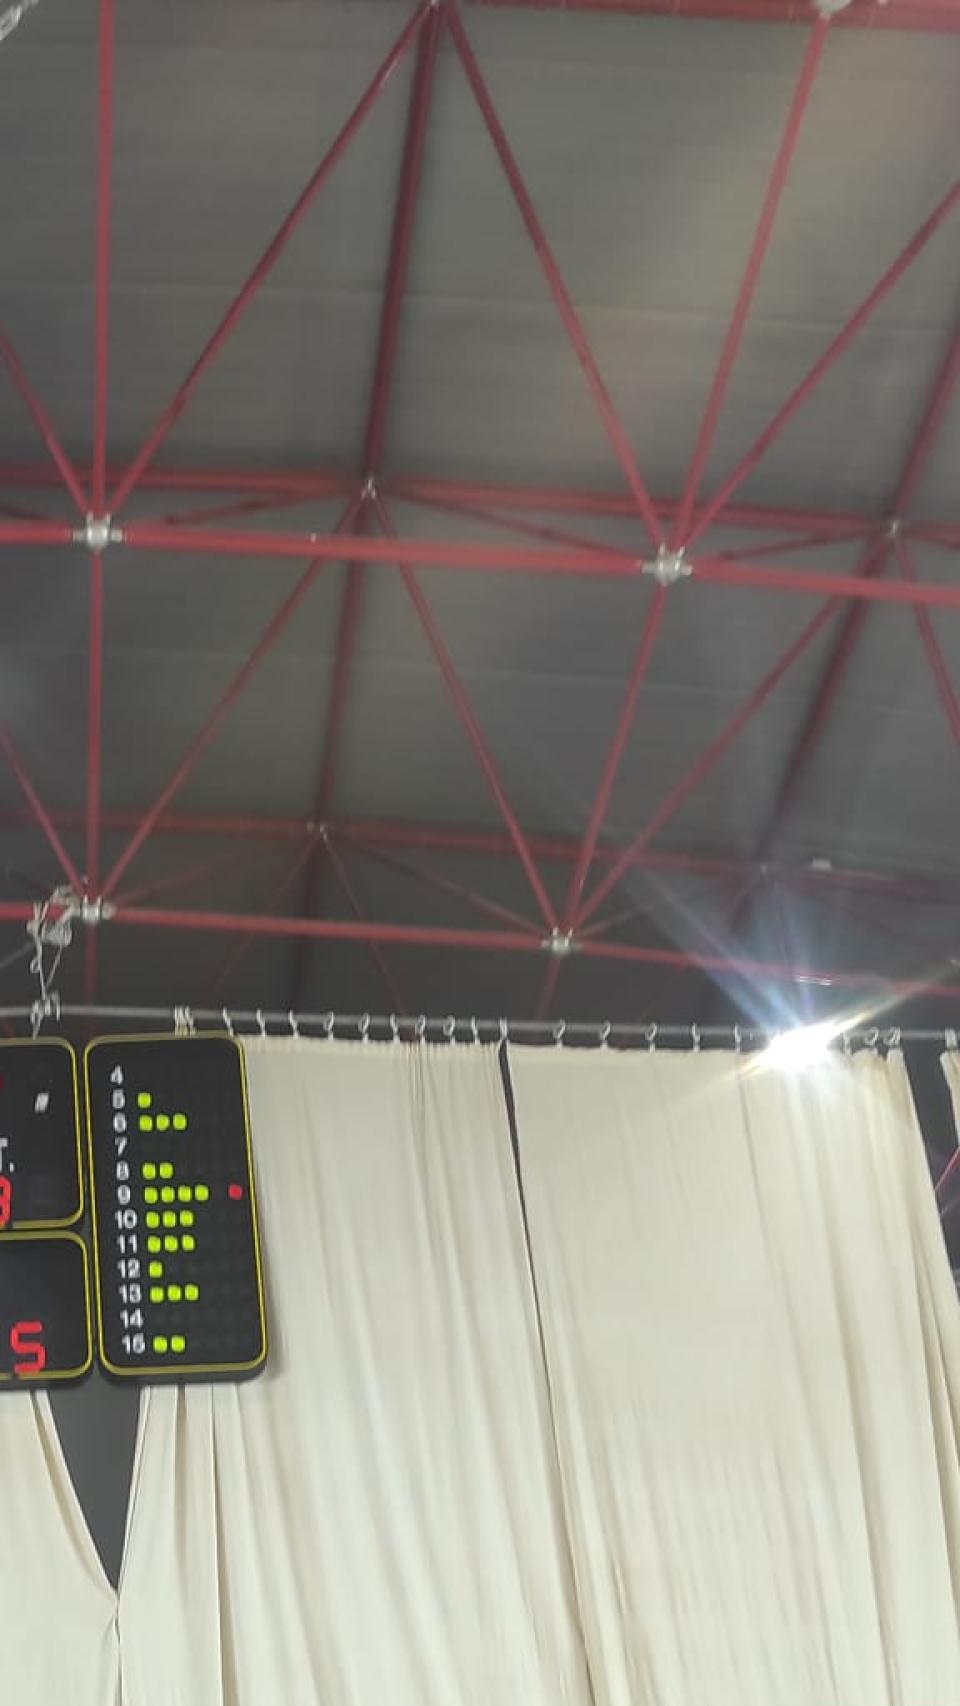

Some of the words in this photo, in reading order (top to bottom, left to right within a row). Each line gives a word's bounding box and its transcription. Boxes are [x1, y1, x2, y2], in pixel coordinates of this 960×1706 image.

[110, 1065, 123, 1085] 4
[112, 1089, 125, 1109] 5
[113, 1112, 127, 1133] 6
[115, 1136, 127, 1156] 7
[116, 1160, 129, 1180] 8
[117, 1184, 130, 1205] 9
[115, 1209, 138, 1229] 10
[116, 1234, 138, 1253] 11
[117, 1258, 140, 1278] 12
[119, 1284, 142, 1304] 13
[120, 1308, 144, 1329] 14
[122, 1333, 146, 1354] 15
